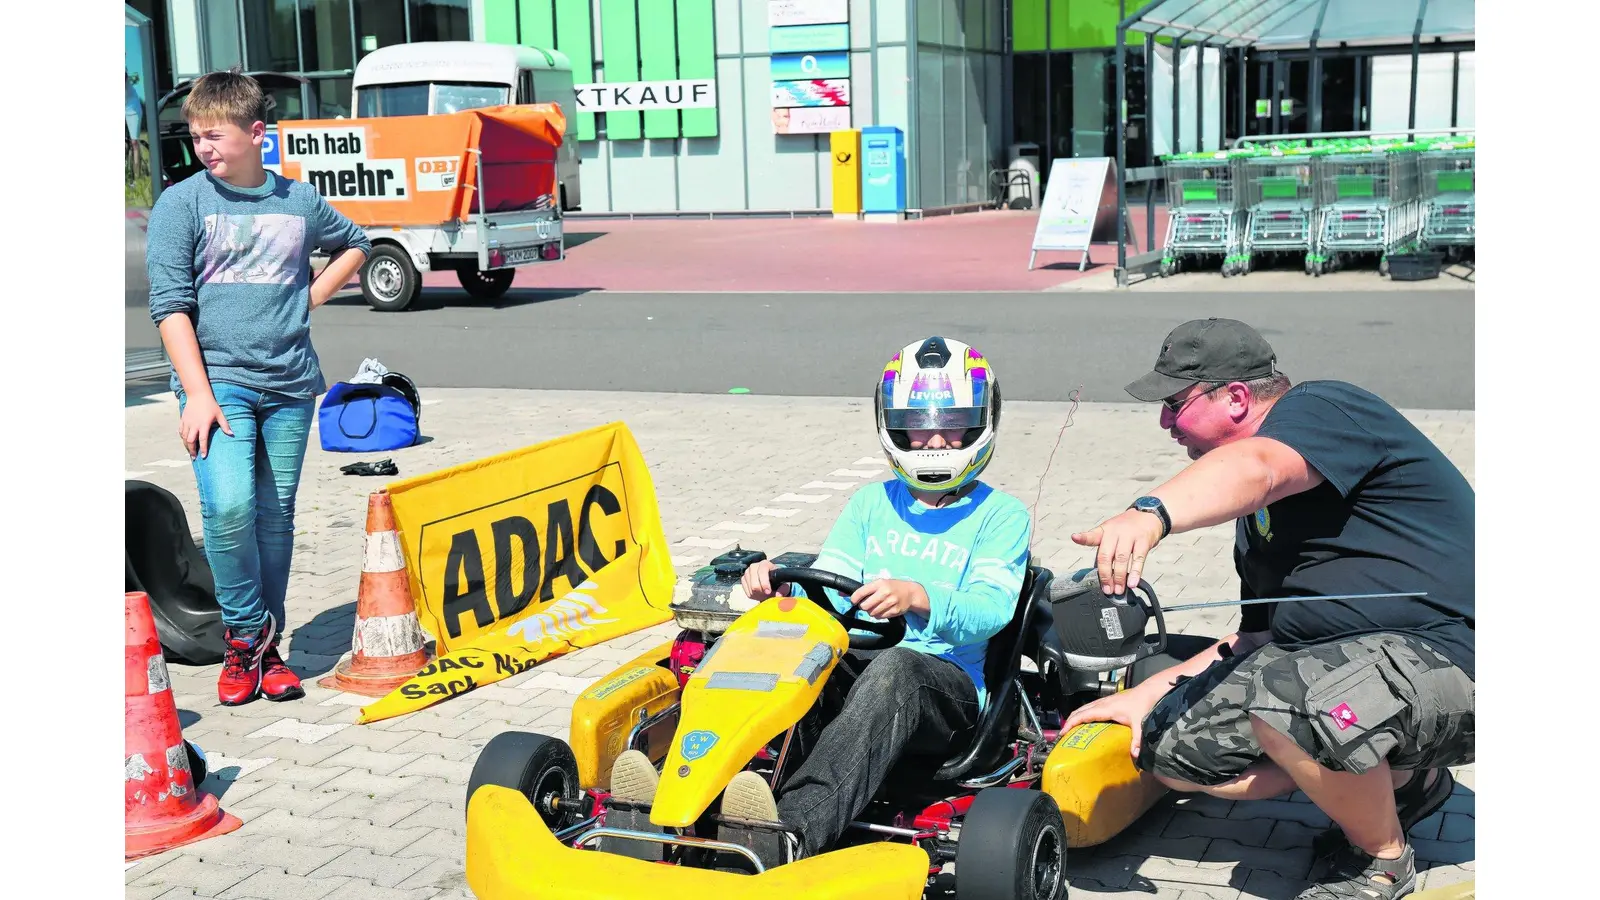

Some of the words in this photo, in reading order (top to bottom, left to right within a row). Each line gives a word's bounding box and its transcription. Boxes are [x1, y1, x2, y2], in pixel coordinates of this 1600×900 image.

[286, 133, 320, 156] Ich
[324, 131, 361, 155] hab
[307, 162, 405, 197] mehr.
[418, 160, 458, 173] OBI
[909, 389, 952, 401] LEVIOR
[441, 483, 628, 640] ADAC
[865, 529, 969, 573] ARCATA
